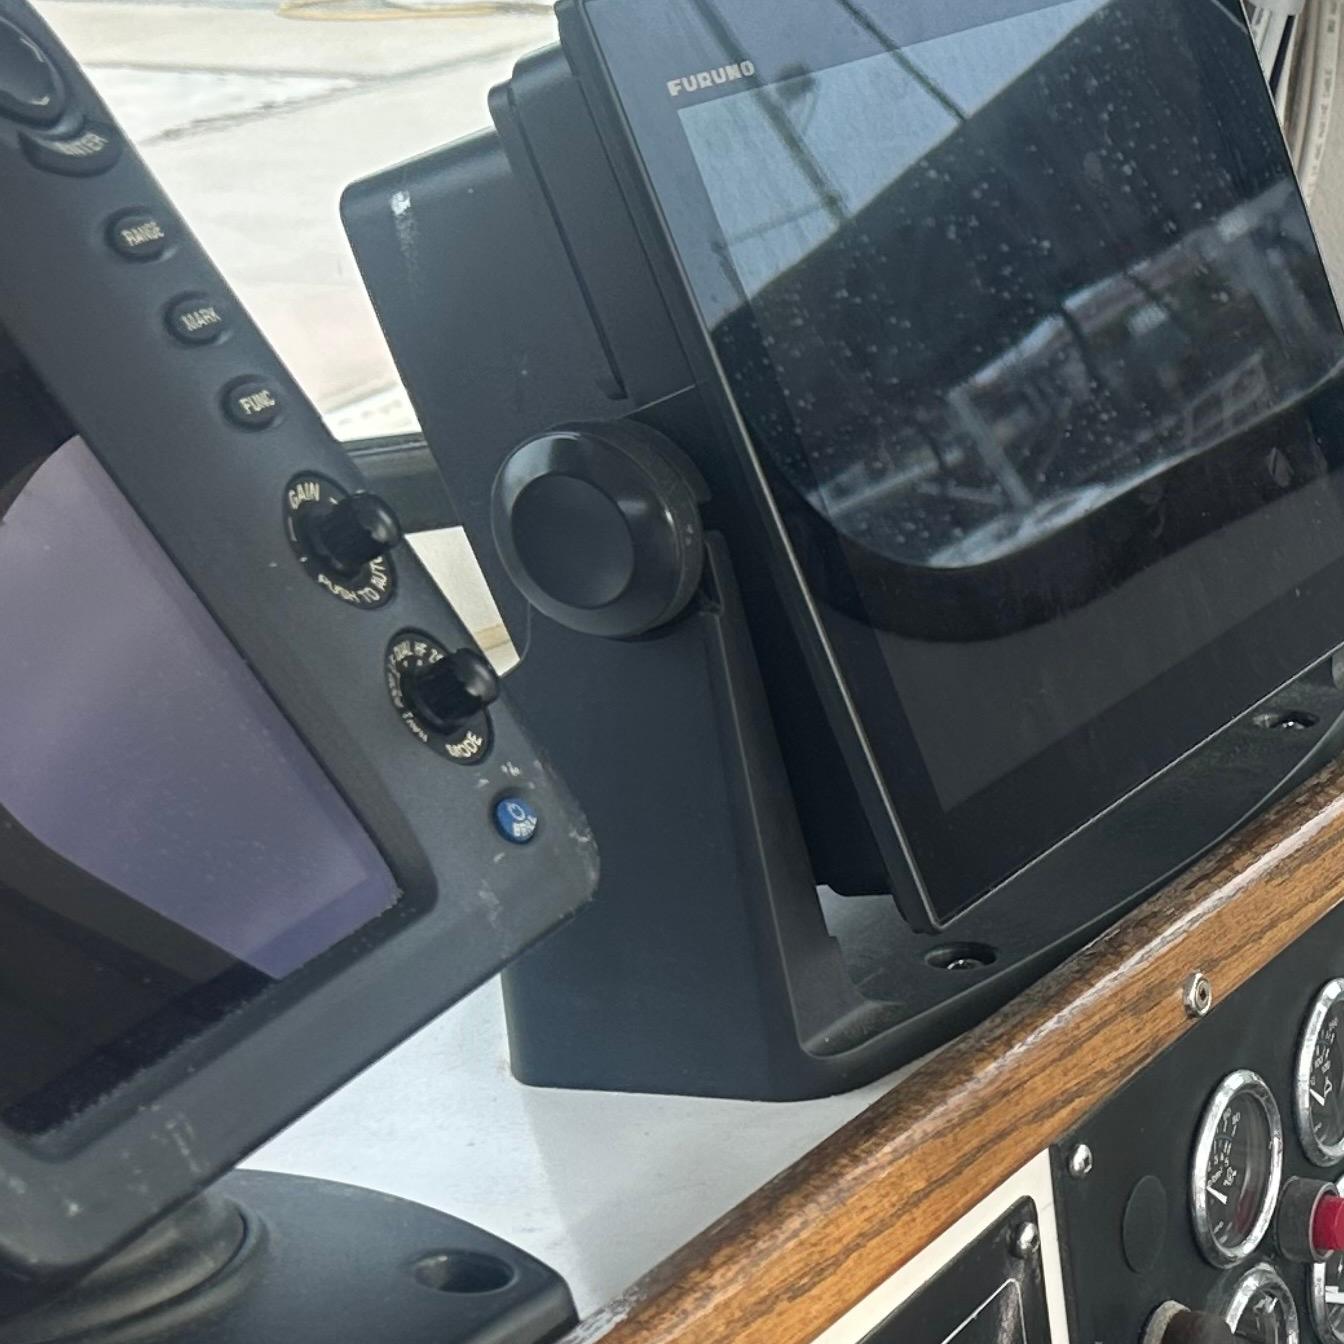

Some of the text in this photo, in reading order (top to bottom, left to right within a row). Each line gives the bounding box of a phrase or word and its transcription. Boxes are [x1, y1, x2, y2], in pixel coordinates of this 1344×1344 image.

[666, 59, 756, 97] FURUNO
[120, 219, 165, 248] RANGE
[180, 306, 223, 332] MARK
[237, 388, 276, 416] FUNC
[288, 481, 321, 511] GAIN
[356, 586, 381, 604] TO
[445, 730, 484, 758] MODE
